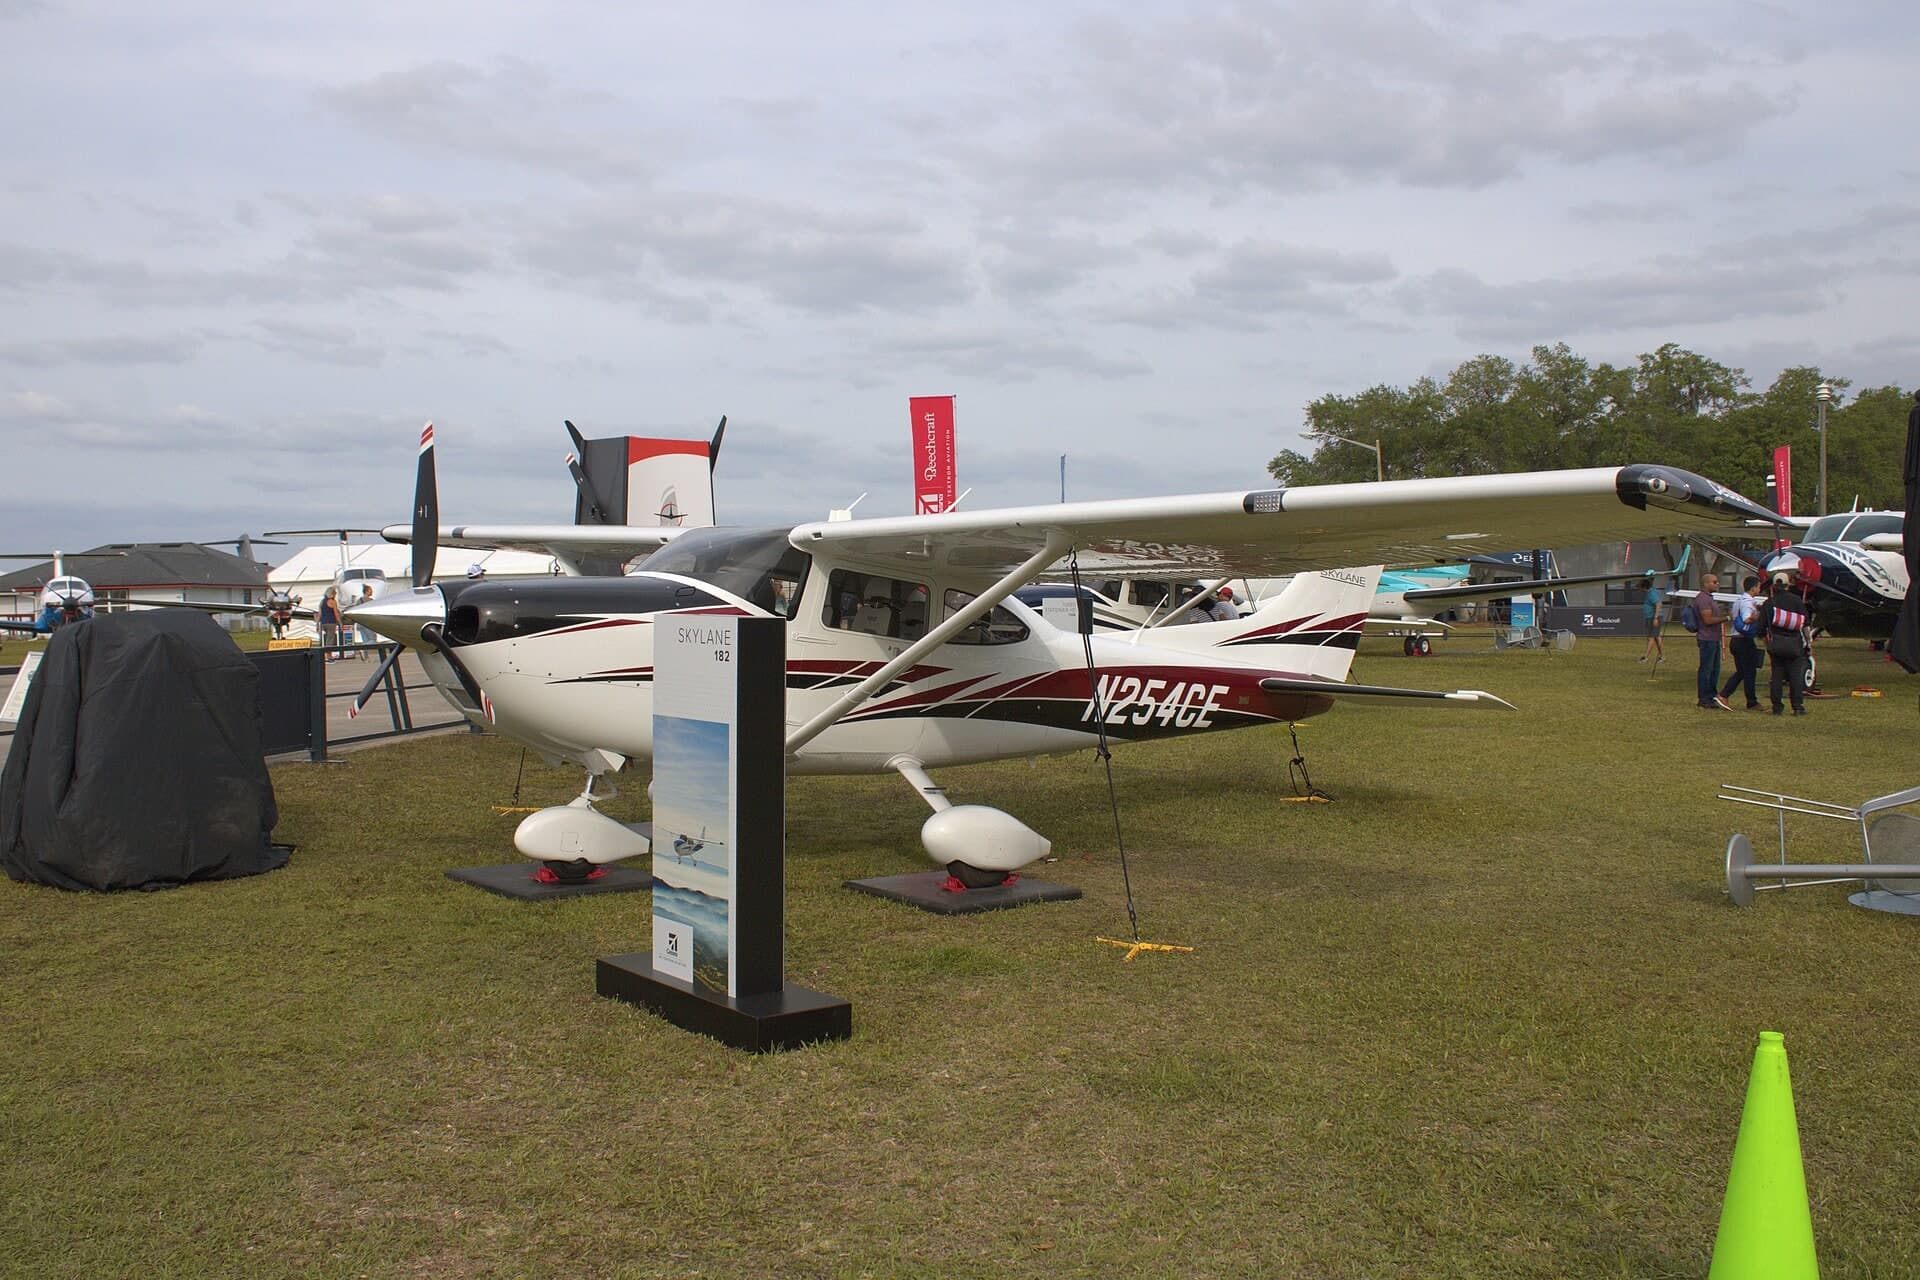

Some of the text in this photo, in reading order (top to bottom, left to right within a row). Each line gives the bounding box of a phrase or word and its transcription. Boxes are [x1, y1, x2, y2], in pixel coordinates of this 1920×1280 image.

[924, 412, 937, 481] Beechcraft
[1320, 569, 1366, 585] SKYLANE
[678, 627, 731, 646] SKYLANE
[714, 650, 730, 662] 182
[1081, 674, 1230, 728] N254CE
